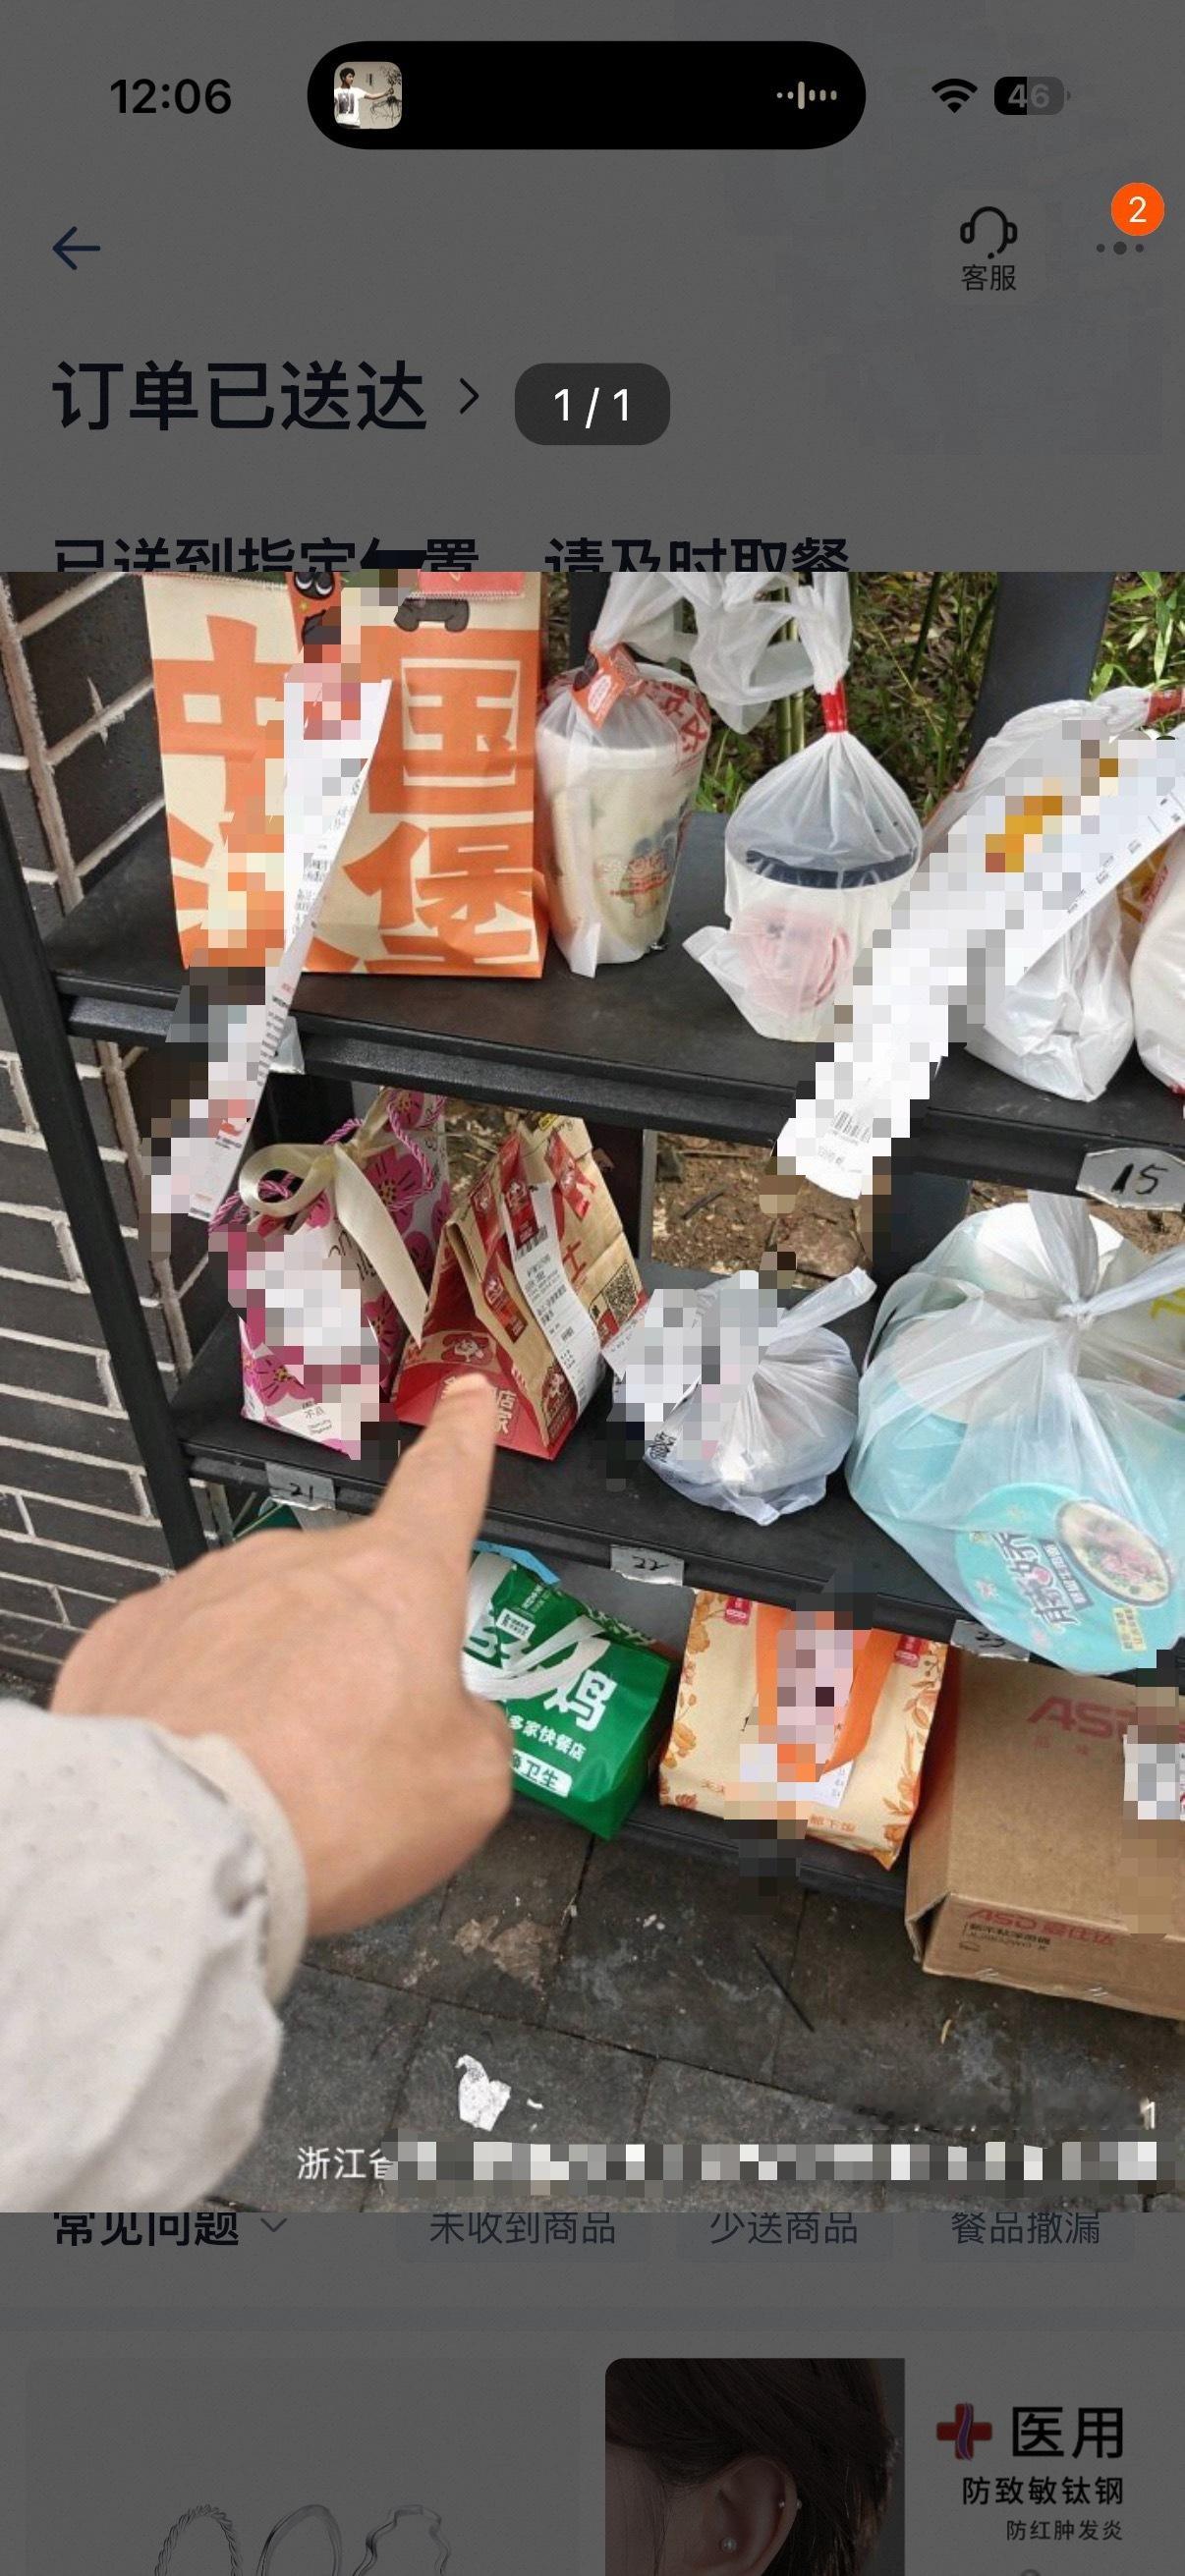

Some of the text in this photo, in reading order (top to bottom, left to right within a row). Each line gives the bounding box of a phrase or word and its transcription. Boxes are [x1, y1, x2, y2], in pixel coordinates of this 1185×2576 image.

[111, 79, 231, 114] 12:06
[1008, 84, 1050, 109] 46
[1129, 196, 1148, 223] 2
[961, 263, 1017, 292] 客服
[52, 360, 426, 430] 订单已送达
[1111, 1163, 1169, 1195] 15
[509, 1714, 587, 1763] 多家快餐店
[969, 1908, 1038, 1931] ASD
[54, 2212, 239, 2247] 常见问题
[430, 2212, 614, 2245] 未收到商品
[710, 2212, 858, 2245] 少送商品
[951, 2212, 1100, 2245] 餐品撒漏
[1012, 2406, 1124, 2459] 医用
[962, 2476, 1123, 2505] 防致敏钛钢
[1006, 2519, 1123, 2541] 防红肿发炎
